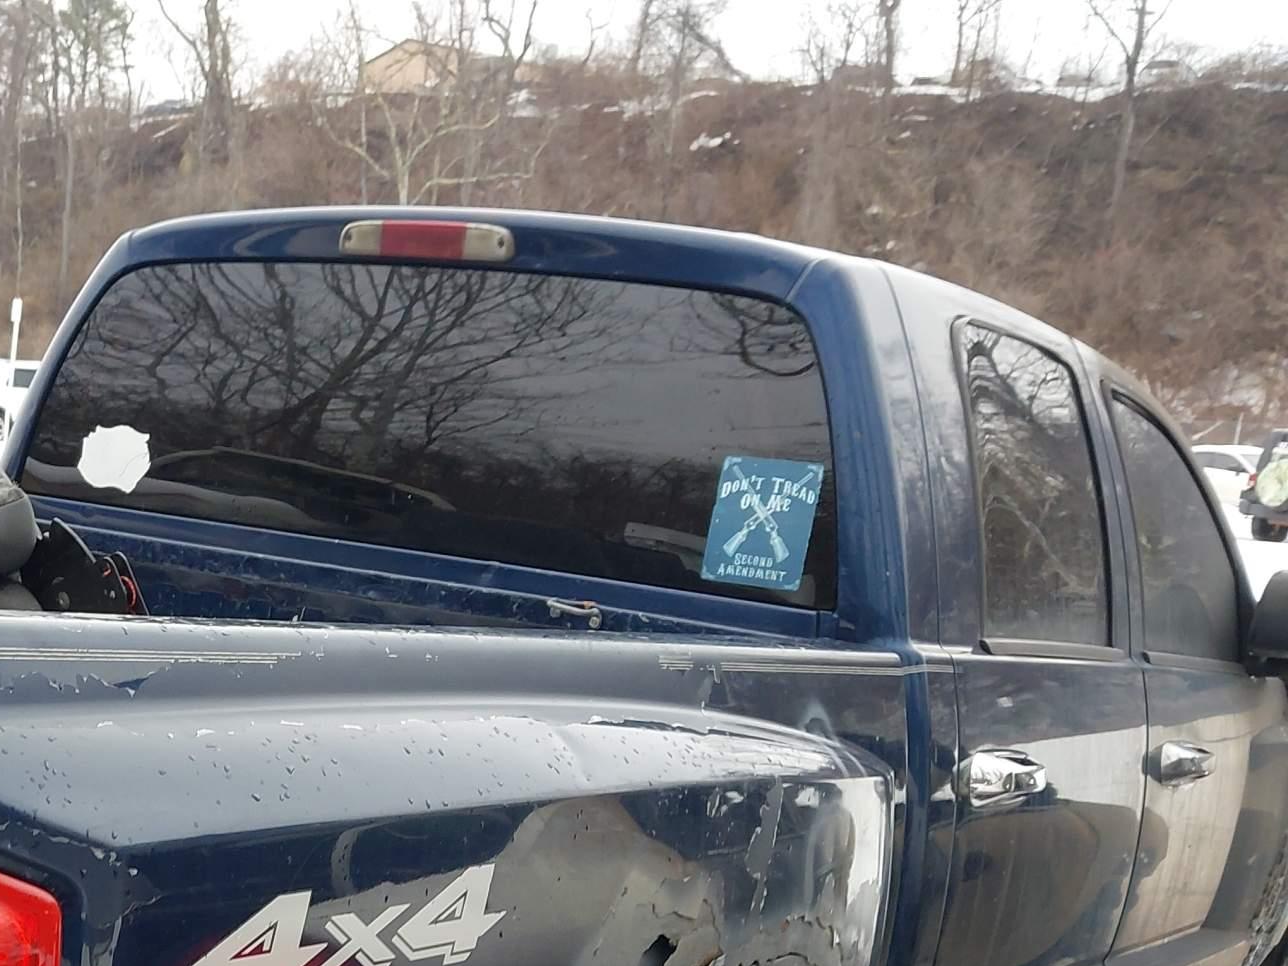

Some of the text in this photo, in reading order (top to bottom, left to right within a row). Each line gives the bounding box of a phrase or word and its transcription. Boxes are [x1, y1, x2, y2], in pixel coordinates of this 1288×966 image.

[720, 475, 816, 505] DON'T TREAD
[740, 493, 792, 512] ON ME
[733, 552, 774, 568] SECOND
[716, 562, 787, 582] AMENDMENT
